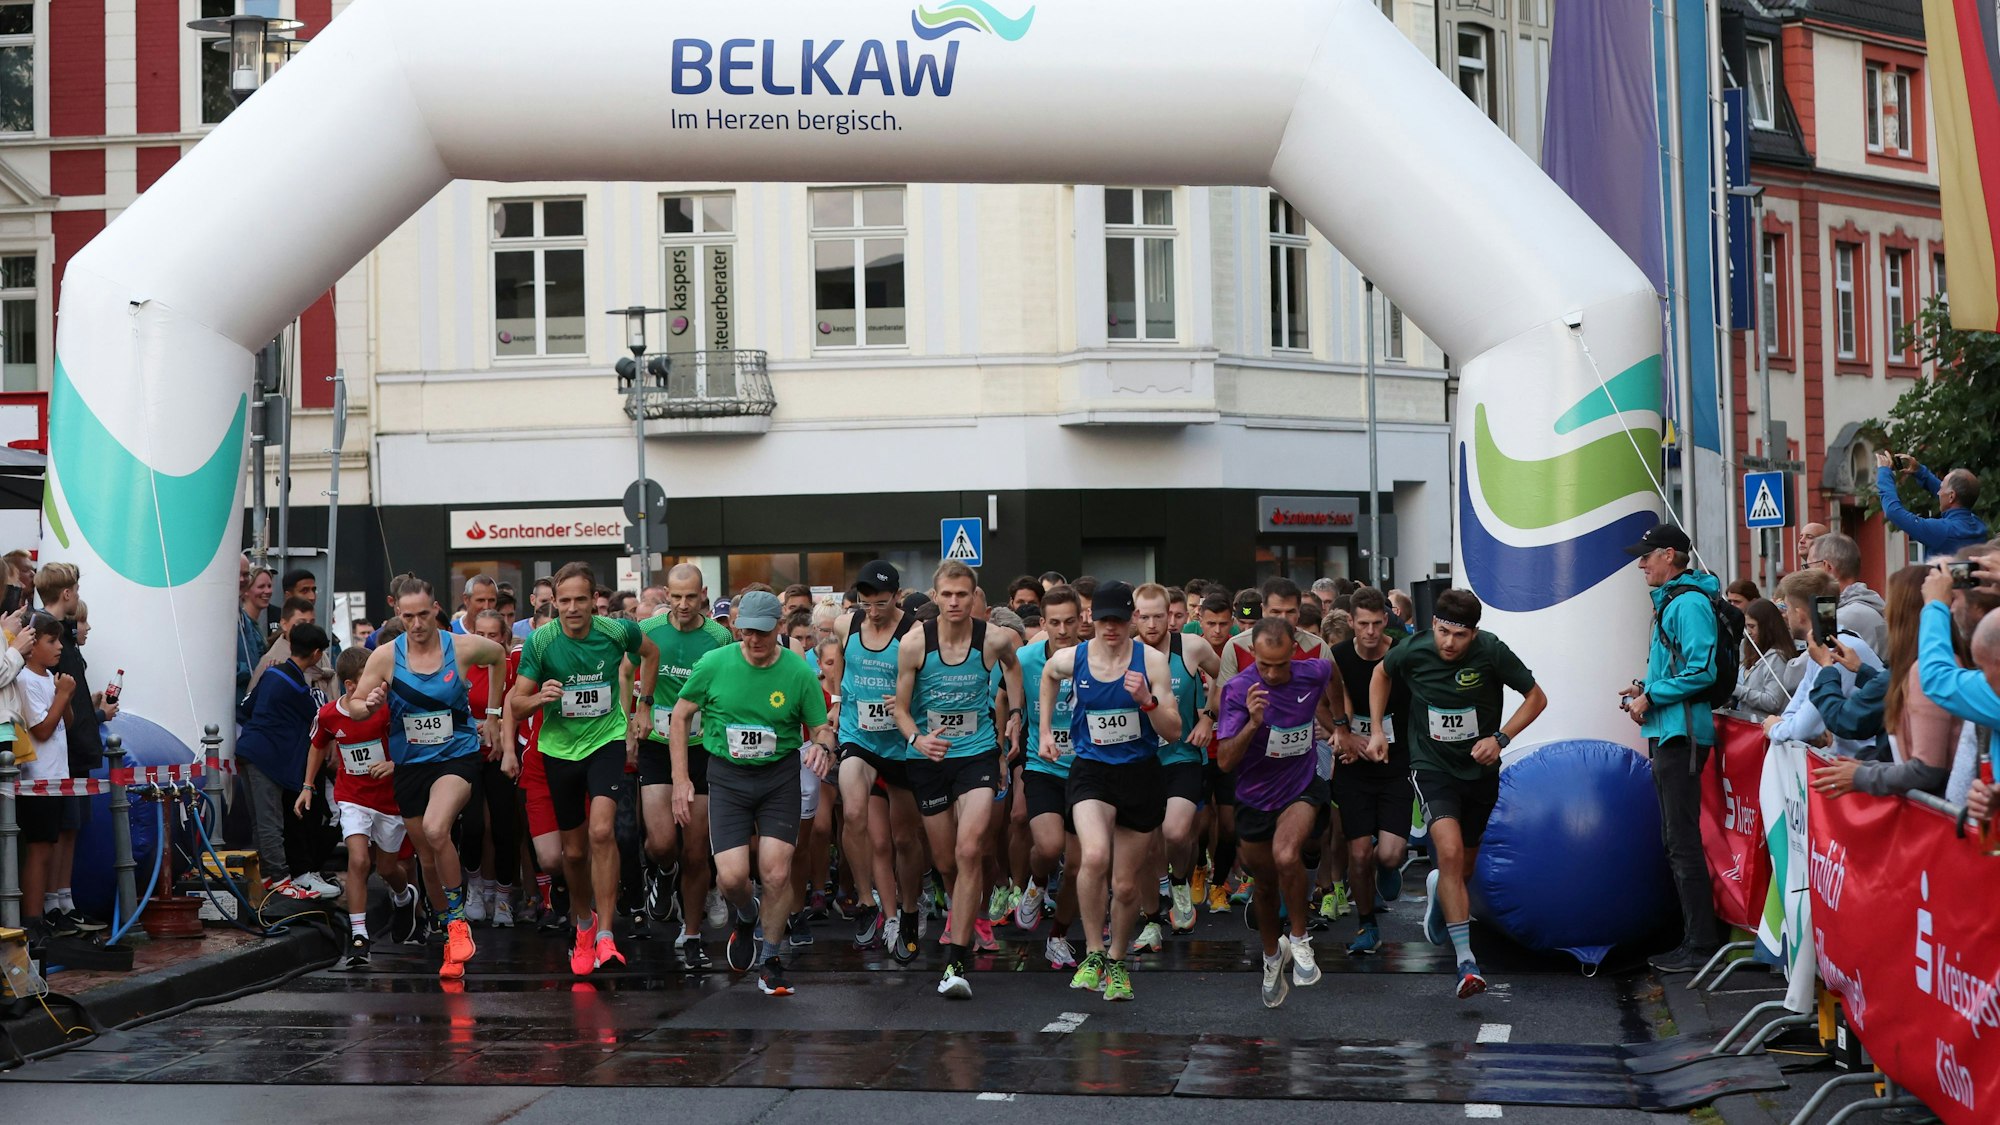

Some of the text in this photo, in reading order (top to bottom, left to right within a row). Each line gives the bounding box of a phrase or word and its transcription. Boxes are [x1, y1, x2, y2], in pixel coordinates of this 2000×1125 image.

[671, 38, 960, 97] BELKAW
[671, 108, 902, 135] Im Herzen bergisch.
[669, 249, 691, 311] kaspers
[711, 249, 729, 350] steuerberater
[489, 522, 621, 539] Santander Select
[671, 666, 692, 676] bune
[862, 659, 895, 669] REFRATH
[577, 672, 603, 681] bunert
[575, 690, 599, 704] 209
[414, 717, 442, 730] 348
[940, 715, 964, 726] 223
[1098, 715, 1127, 729] 340
[1441, 715, 1463, 728] 212
[741, 731, 762, 745] 281
[1281, 729, 1308, 744] 333
[350, 747, 371, 762] 102
[1937, 943, 2000, 1039] Kreisspar
[1936, 1037, 1975, 1111] Köln
